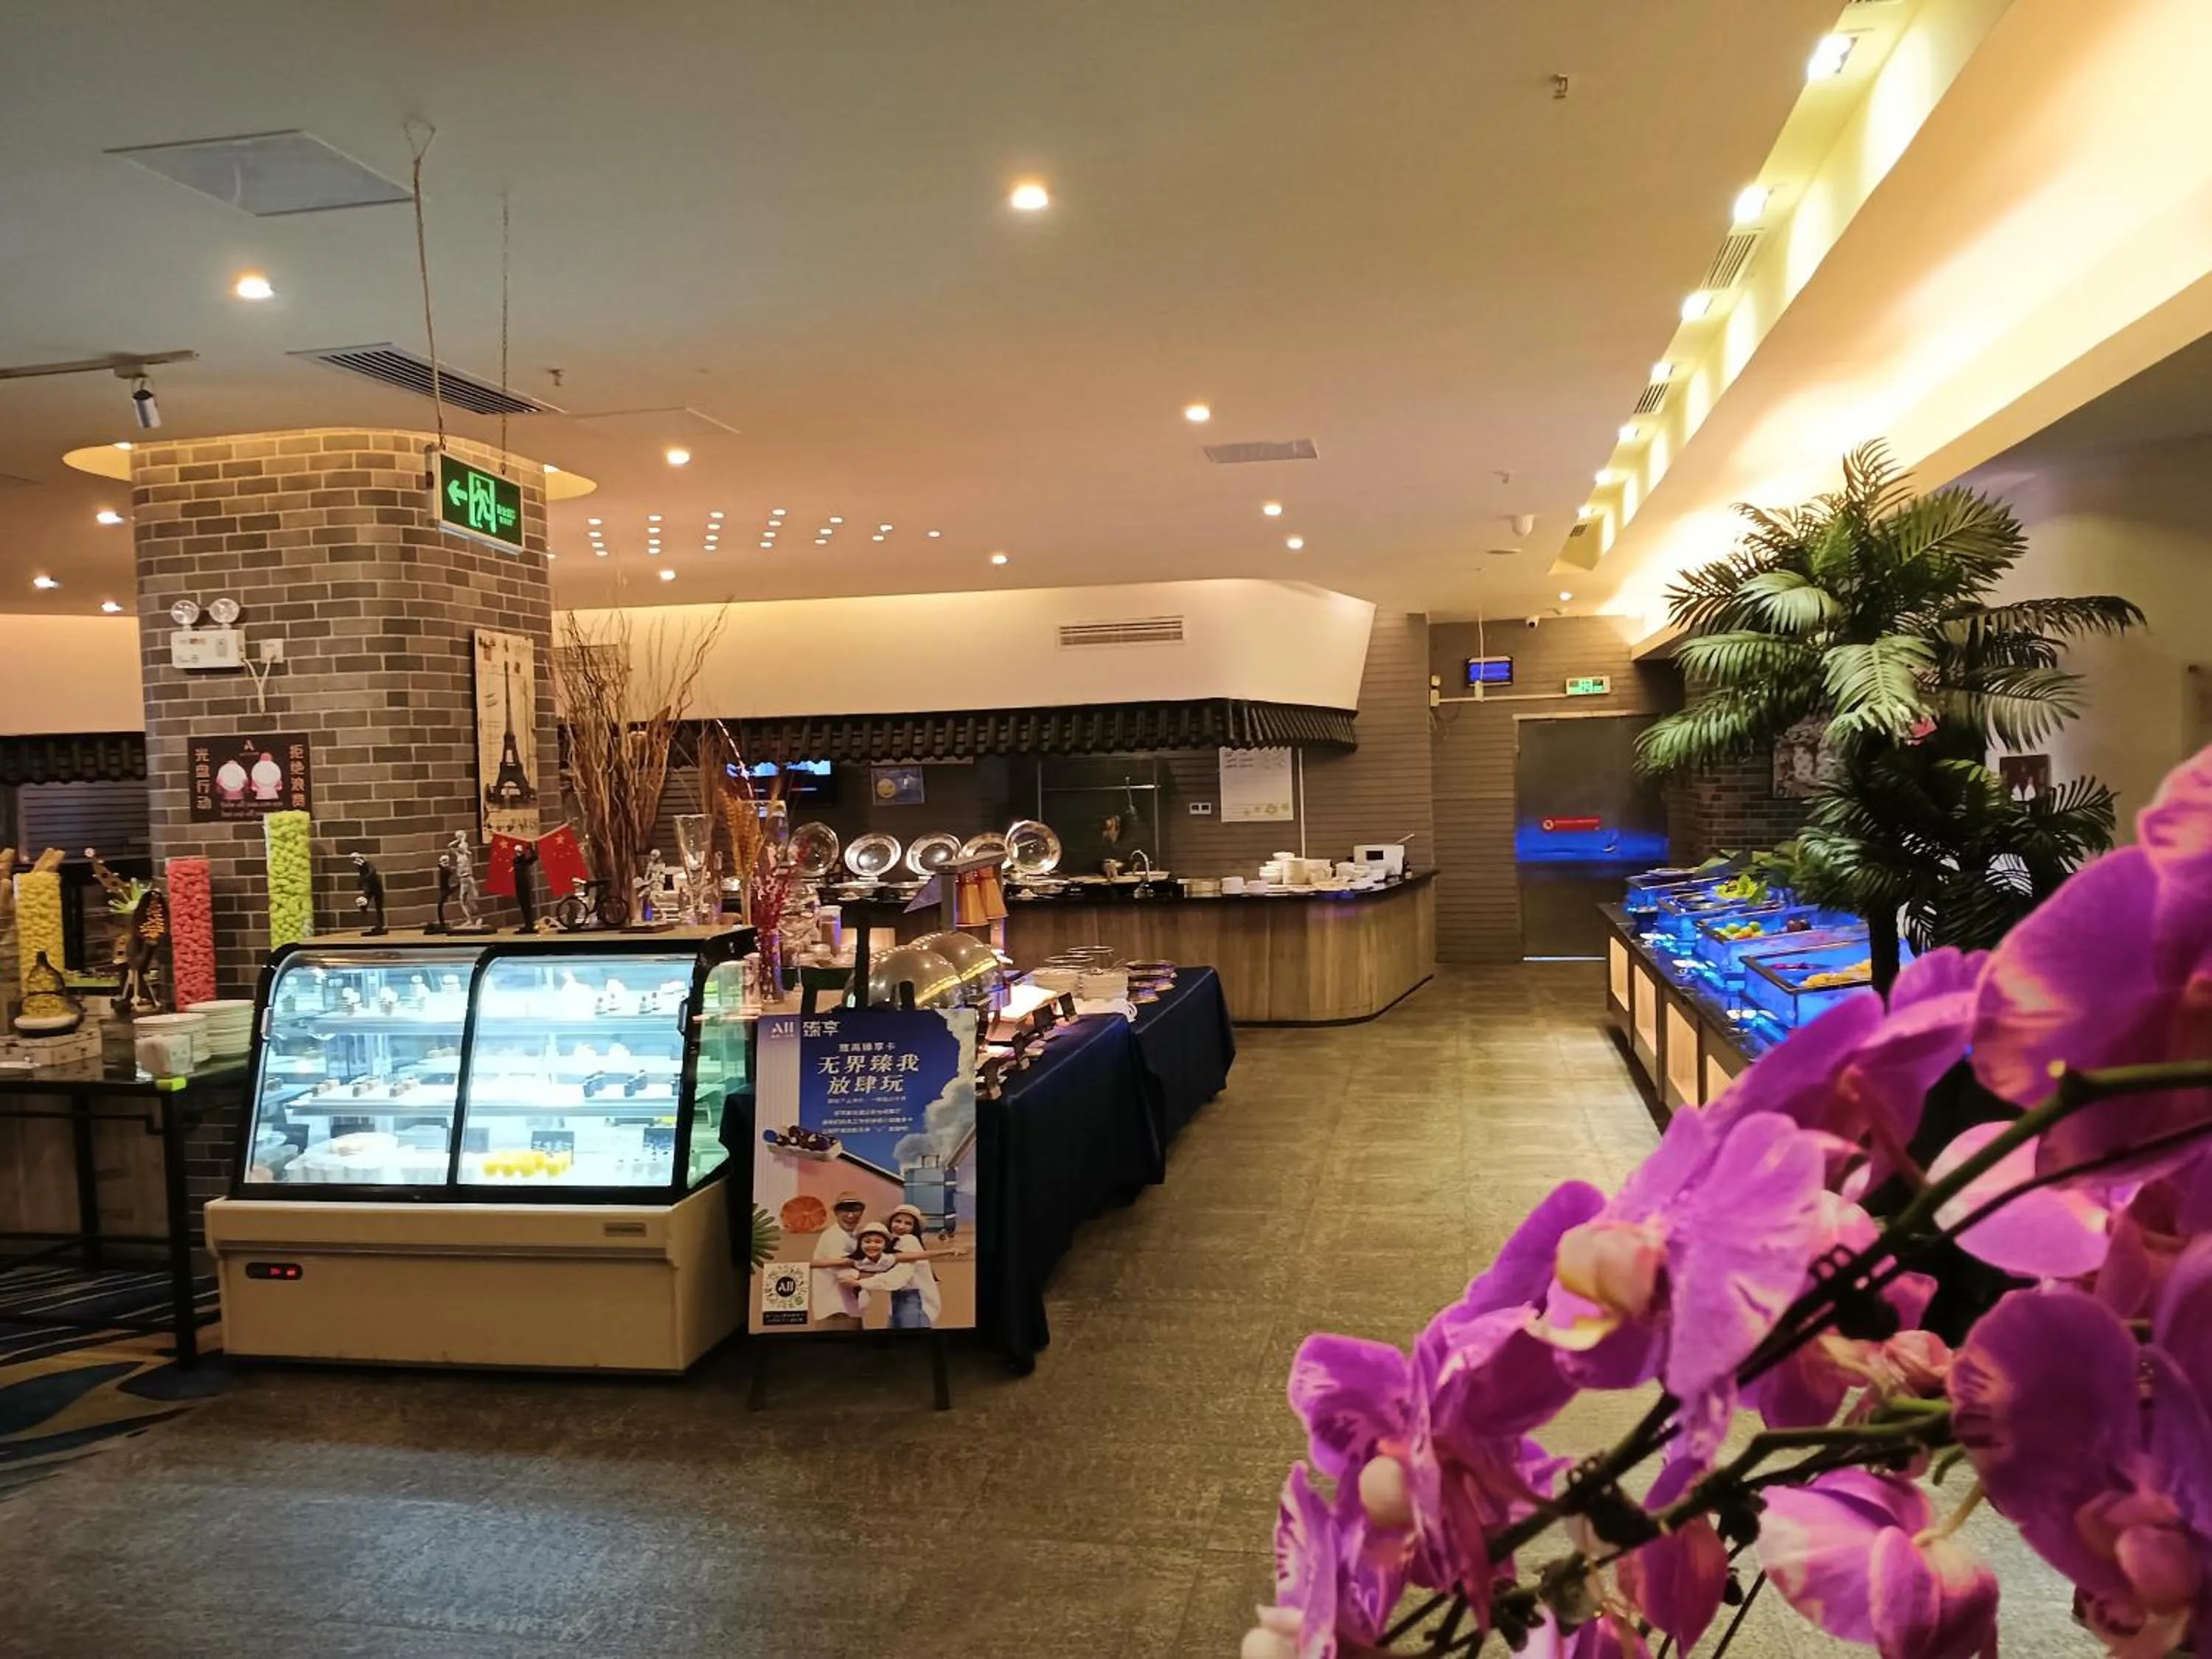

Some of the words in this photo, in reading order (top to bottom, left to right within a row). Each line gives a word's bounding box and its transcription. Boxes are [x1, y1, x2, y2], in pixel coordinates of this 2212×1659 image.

[817, 1054, 920, 1074] 无界臻我
[827, 1075, 905, 1094] 放肆玩
